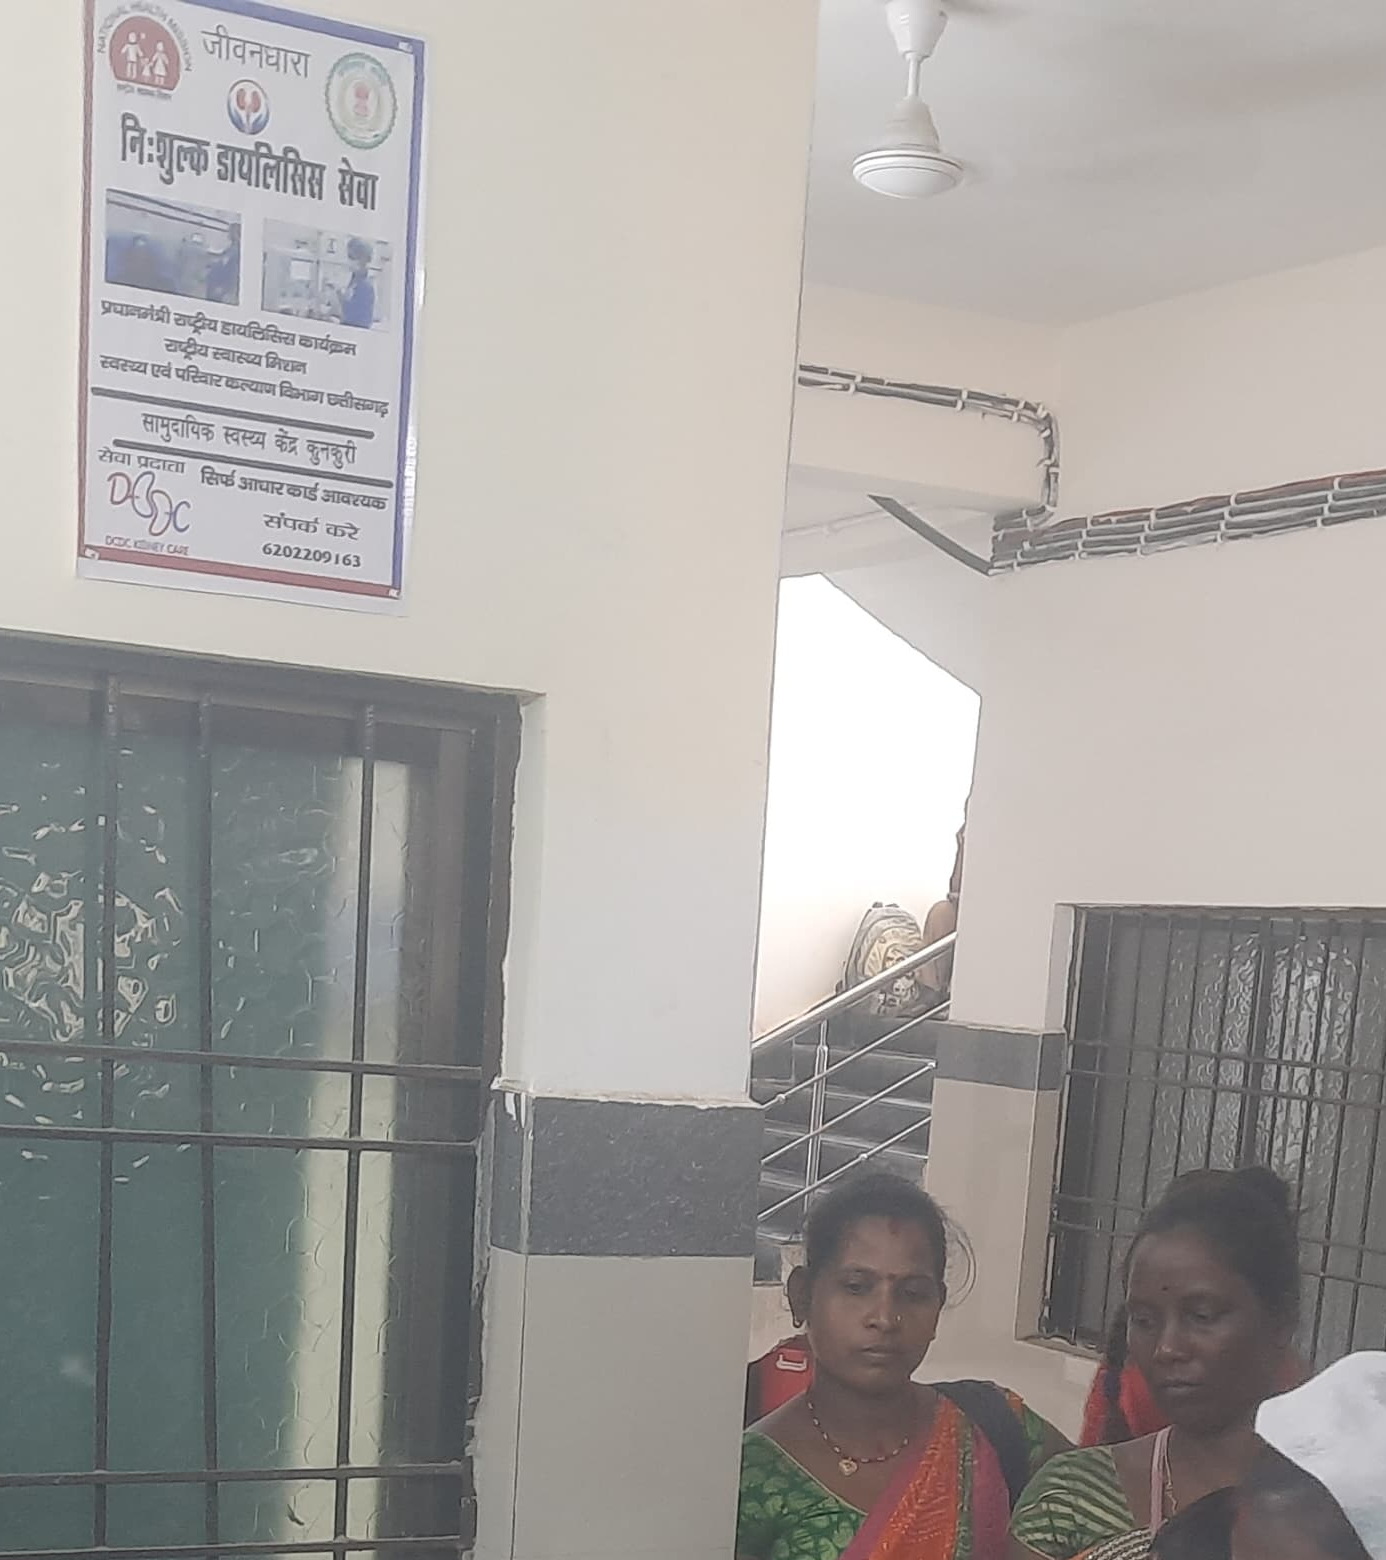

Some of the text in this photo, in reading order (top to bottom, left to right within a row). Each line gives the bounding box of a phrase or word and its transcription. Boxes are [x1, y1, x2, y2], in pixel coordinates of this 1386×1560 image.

[201, 24, 311, 78] जीवनधारा
[216, 141, 327, 200] डायलिसिस
[338, 157, 379, 210] सेवा
[164, 337, 209, 360] राष्ट्रीय
[265, 351, 308, 374] मिशन
[173, 311, 218, 335] राष्ट्रीय
[220, 320, 297, 346] डायलिसिस
[299, 333, 357, 356] कार्यक्रम
[151, 361, 172, 379] एवं
[175, 364, 223, 387] परिवार
[225, 374, 277, 397] कल्याण
[279, 380, 324, 404] विभाग
[97, 446, 186, 474] सेवा प्रदाता
[141, 412, 215, 443] सामुदायिक
[306, 439, 358, 470] कुनकुरी
[200, 465, 389, 511] सिर्फ आधार कार्ड आवश्यक
[263, 512, 321, 533] संपर्क
[262, 542, 361, 568] 6202209163
